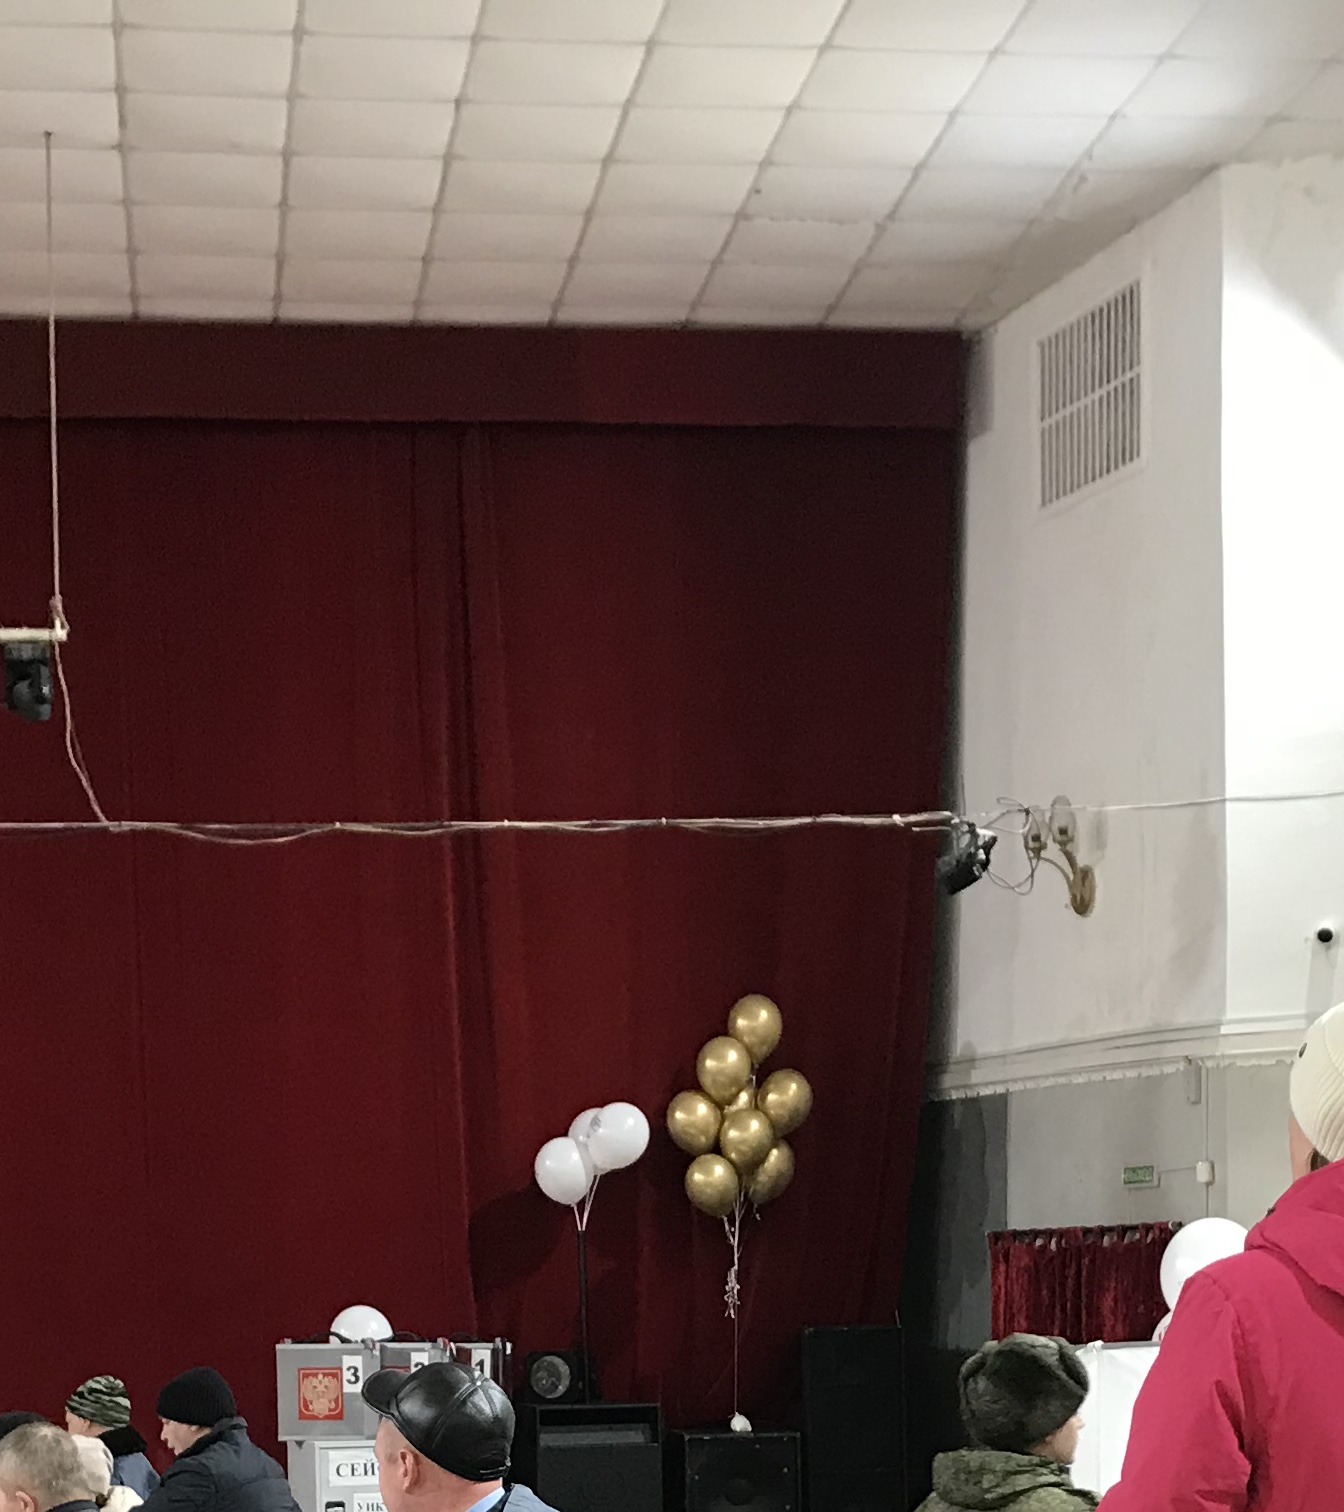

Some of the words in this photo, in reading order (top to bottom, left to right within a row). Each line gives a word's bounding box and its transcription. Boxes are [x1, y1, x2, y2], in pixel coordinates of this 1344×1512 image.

[346, 1366, 360, 1385] 3
[336, 1458, 379, 1478] СЕЙ
[357, 1501, 384, 1512] УИК
